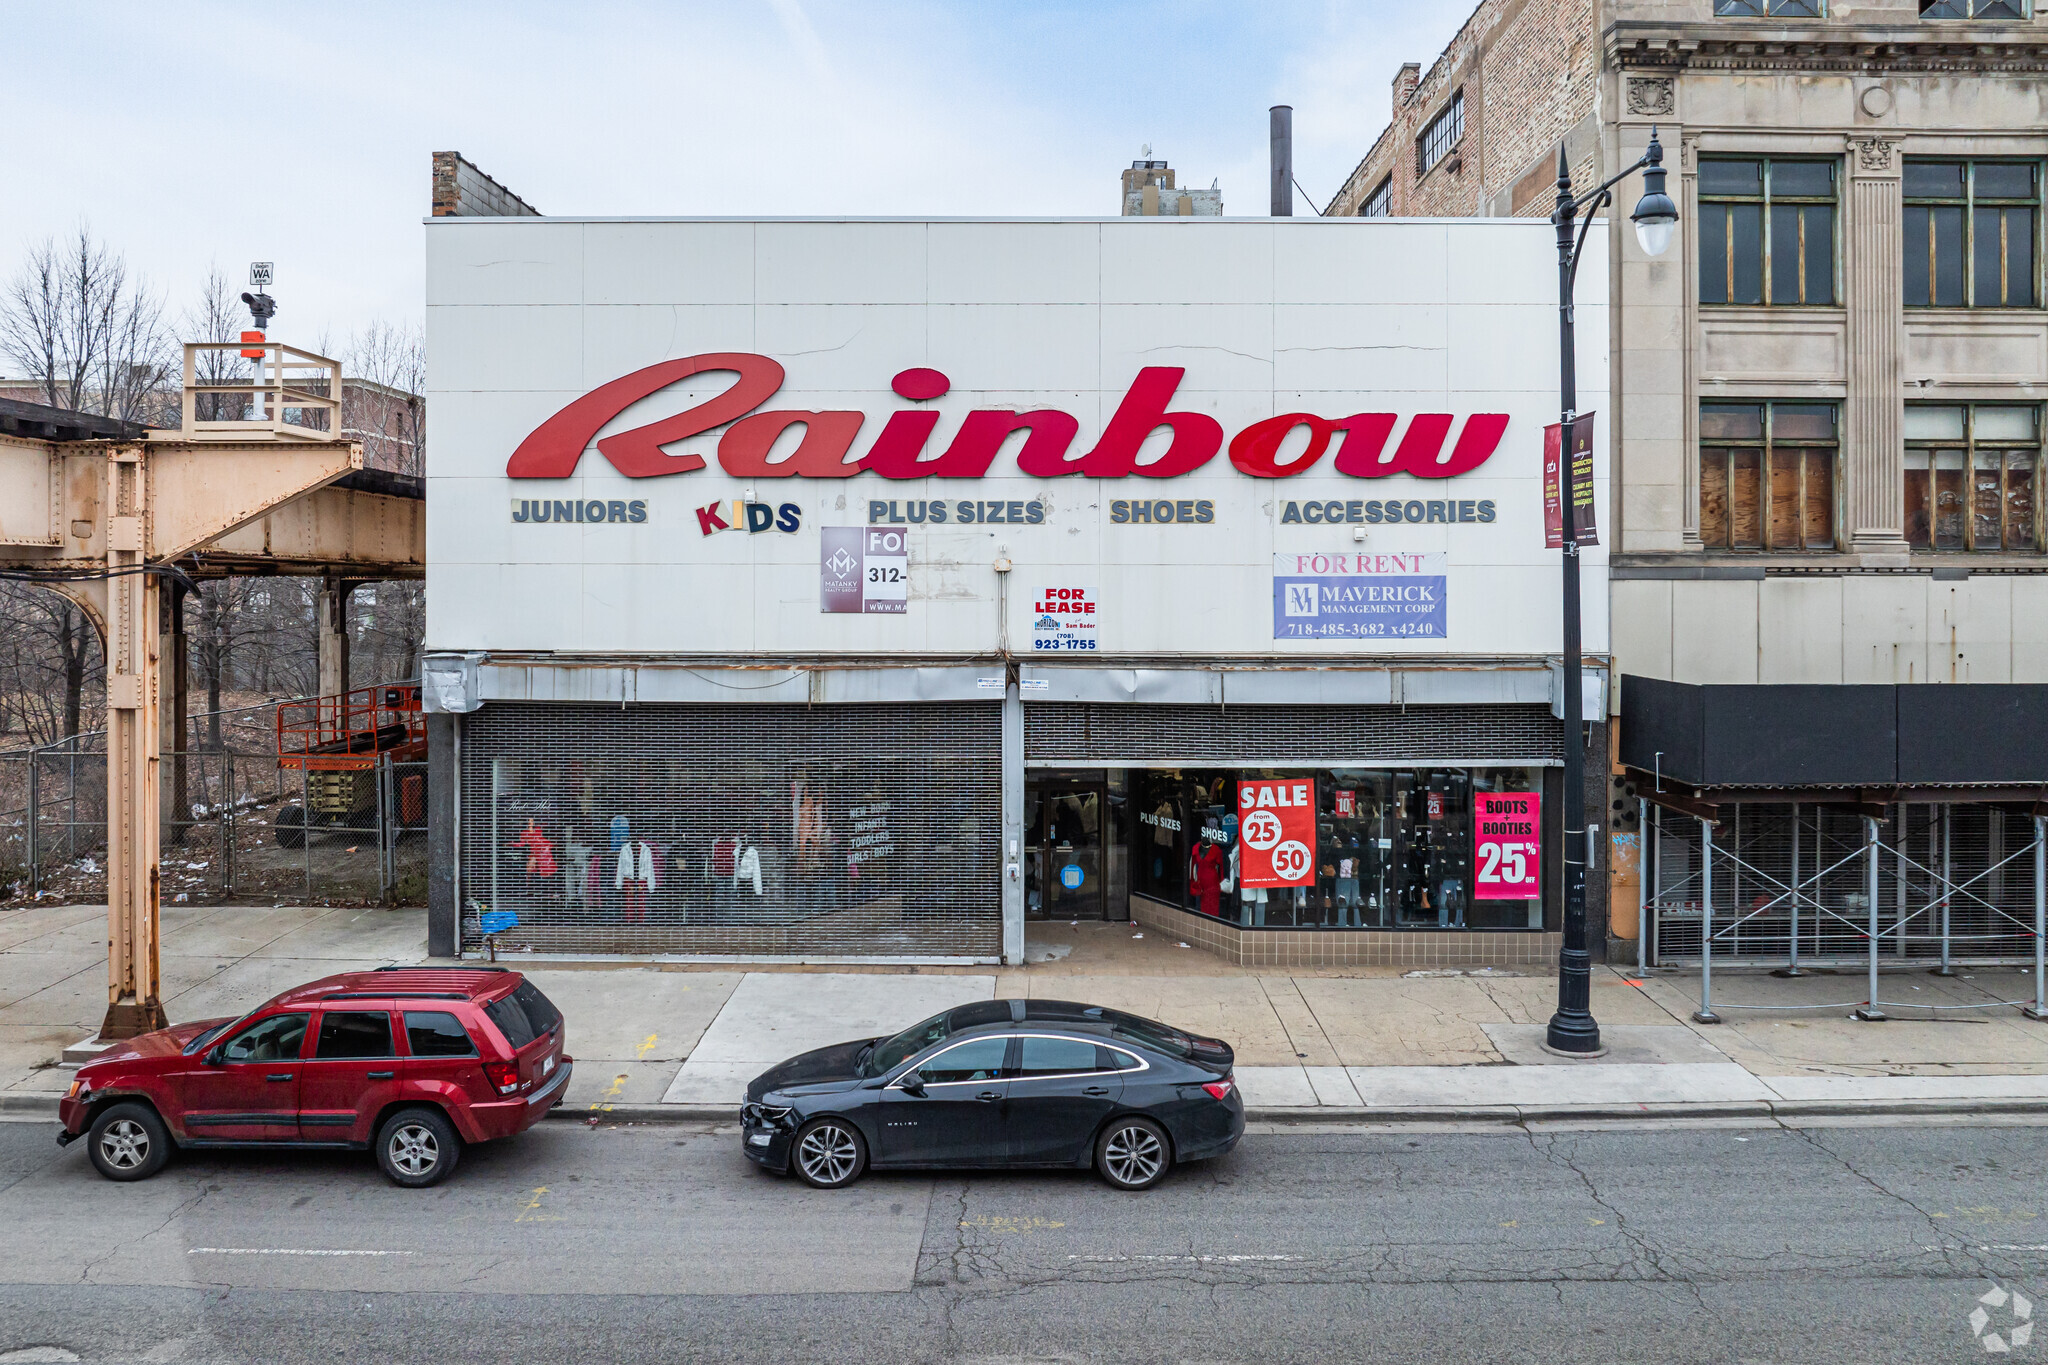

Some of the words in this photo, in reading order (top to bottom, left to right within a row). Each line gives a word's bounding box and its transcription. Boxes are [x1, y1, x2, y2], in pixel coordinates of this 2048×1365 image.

[253, 269, 270, 279] WA
[506, 352, 1510, 479] Rainbow
[512, 500, 647, 523] JUNIORS
[695, 500, 802, 537] KIDS
[869, 500, 948, 524] PLUS
[956, 500, 1046, 524] SIZES
[1111, 500, 1215, 524] SHOES
[1281, 500, 1496, 523] ACCESSORIES
[1296, 555, 1349, 574] FOR
[1356, 554, 1425, 574] RENT
[869, 567, 907, 583] 312-
[1045, 588, 1085, 600] FOR
[1321, 585, 1435, 602] MAVERICK
[1035, 601, 1096, 614] LEASE
[1321, 604, 1402, 614] MANAGEMENT
[1405, 604, 1436, 614] CORP
[1288, 623, 1385, 636] 718-485-3682
[1391, 622, 1434, 635] x4240
[1035, 639, 1096, 650] 923-1755
[1241, 785, 1308, 809] SALE
[1427, 800, 1440, 814] 25
[1485, 800, 1528, 814] BOOTS
[1140, 811, 1159, 826] PLUS
[1160, 816, 1181, 832] SIZES
[1482, 822, 1532, 835] BOOTIES
[1201, 826, 1228, 843] SHOES
[1287, 871, 1298, 879] off
[1525, 876, 1536, 884] OFF
